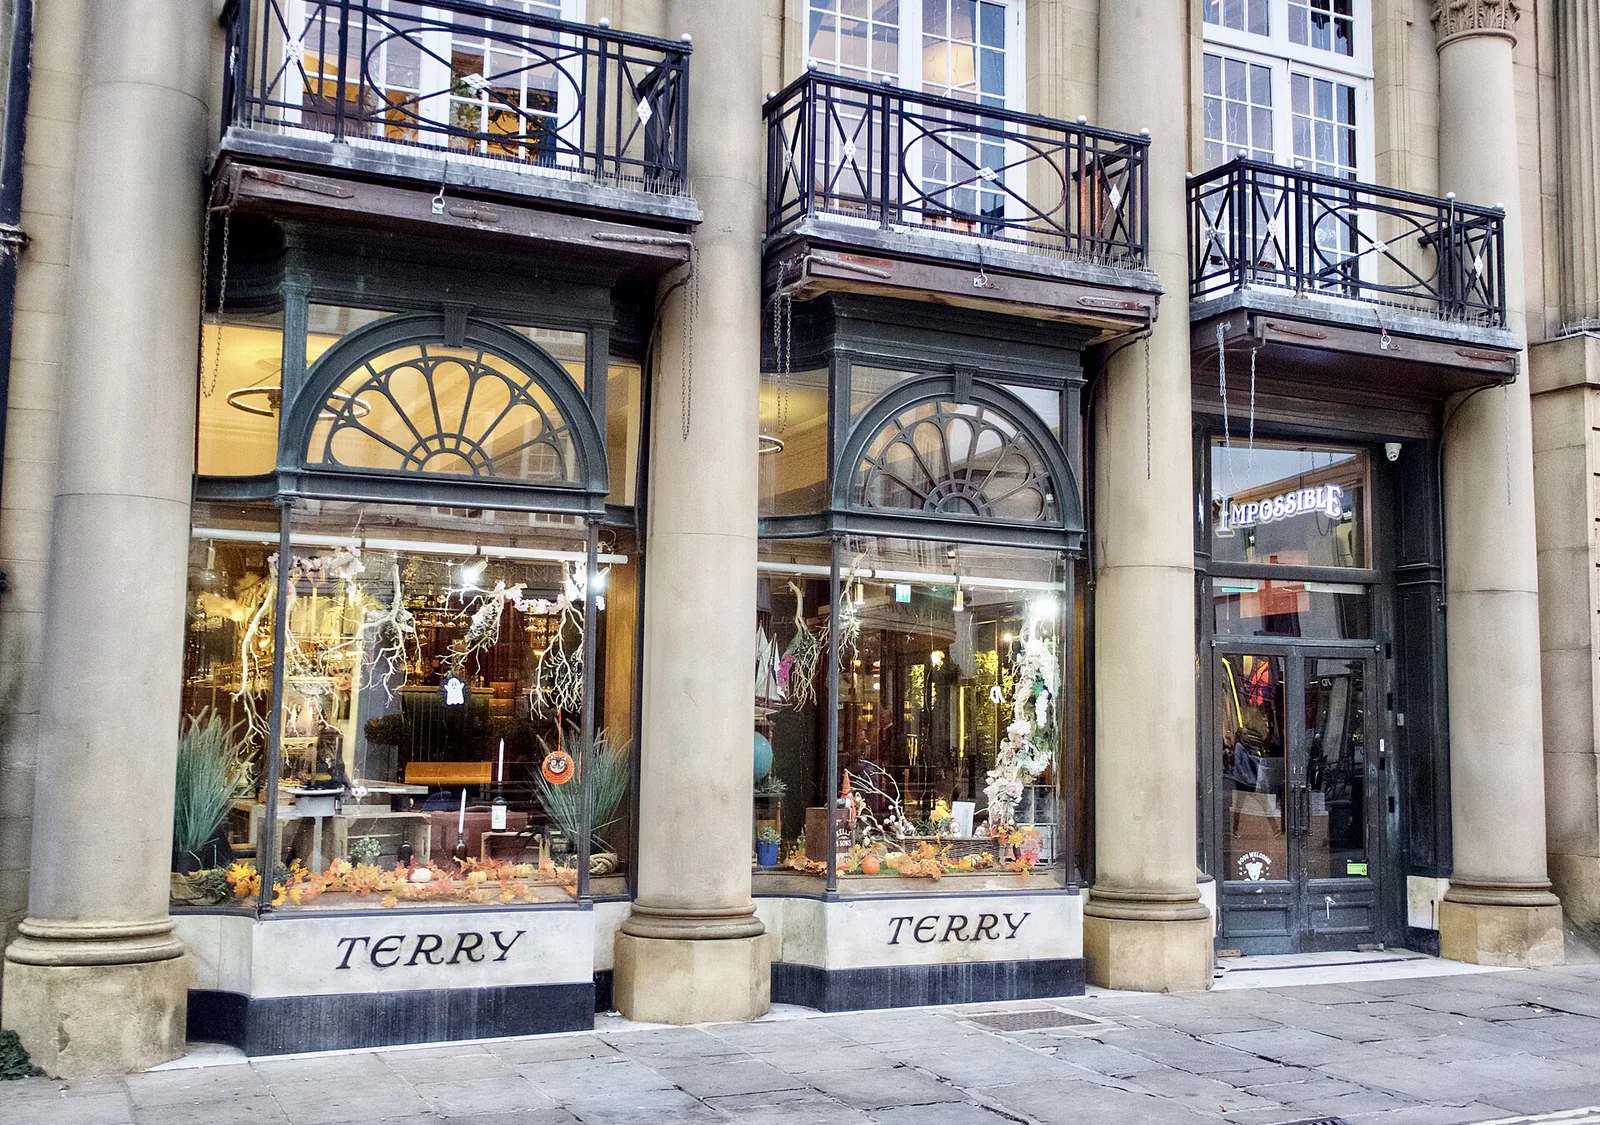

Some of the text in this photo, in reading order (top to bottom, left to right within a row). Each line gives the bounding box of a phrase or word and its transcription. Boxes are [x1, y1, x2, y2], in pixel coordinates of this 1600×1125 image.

[1213, 484, 1343, 537] IMPOSSIBLE
[887, 912, 1031, 945] TERRY
[335, 930, 527, 970] TERRY
